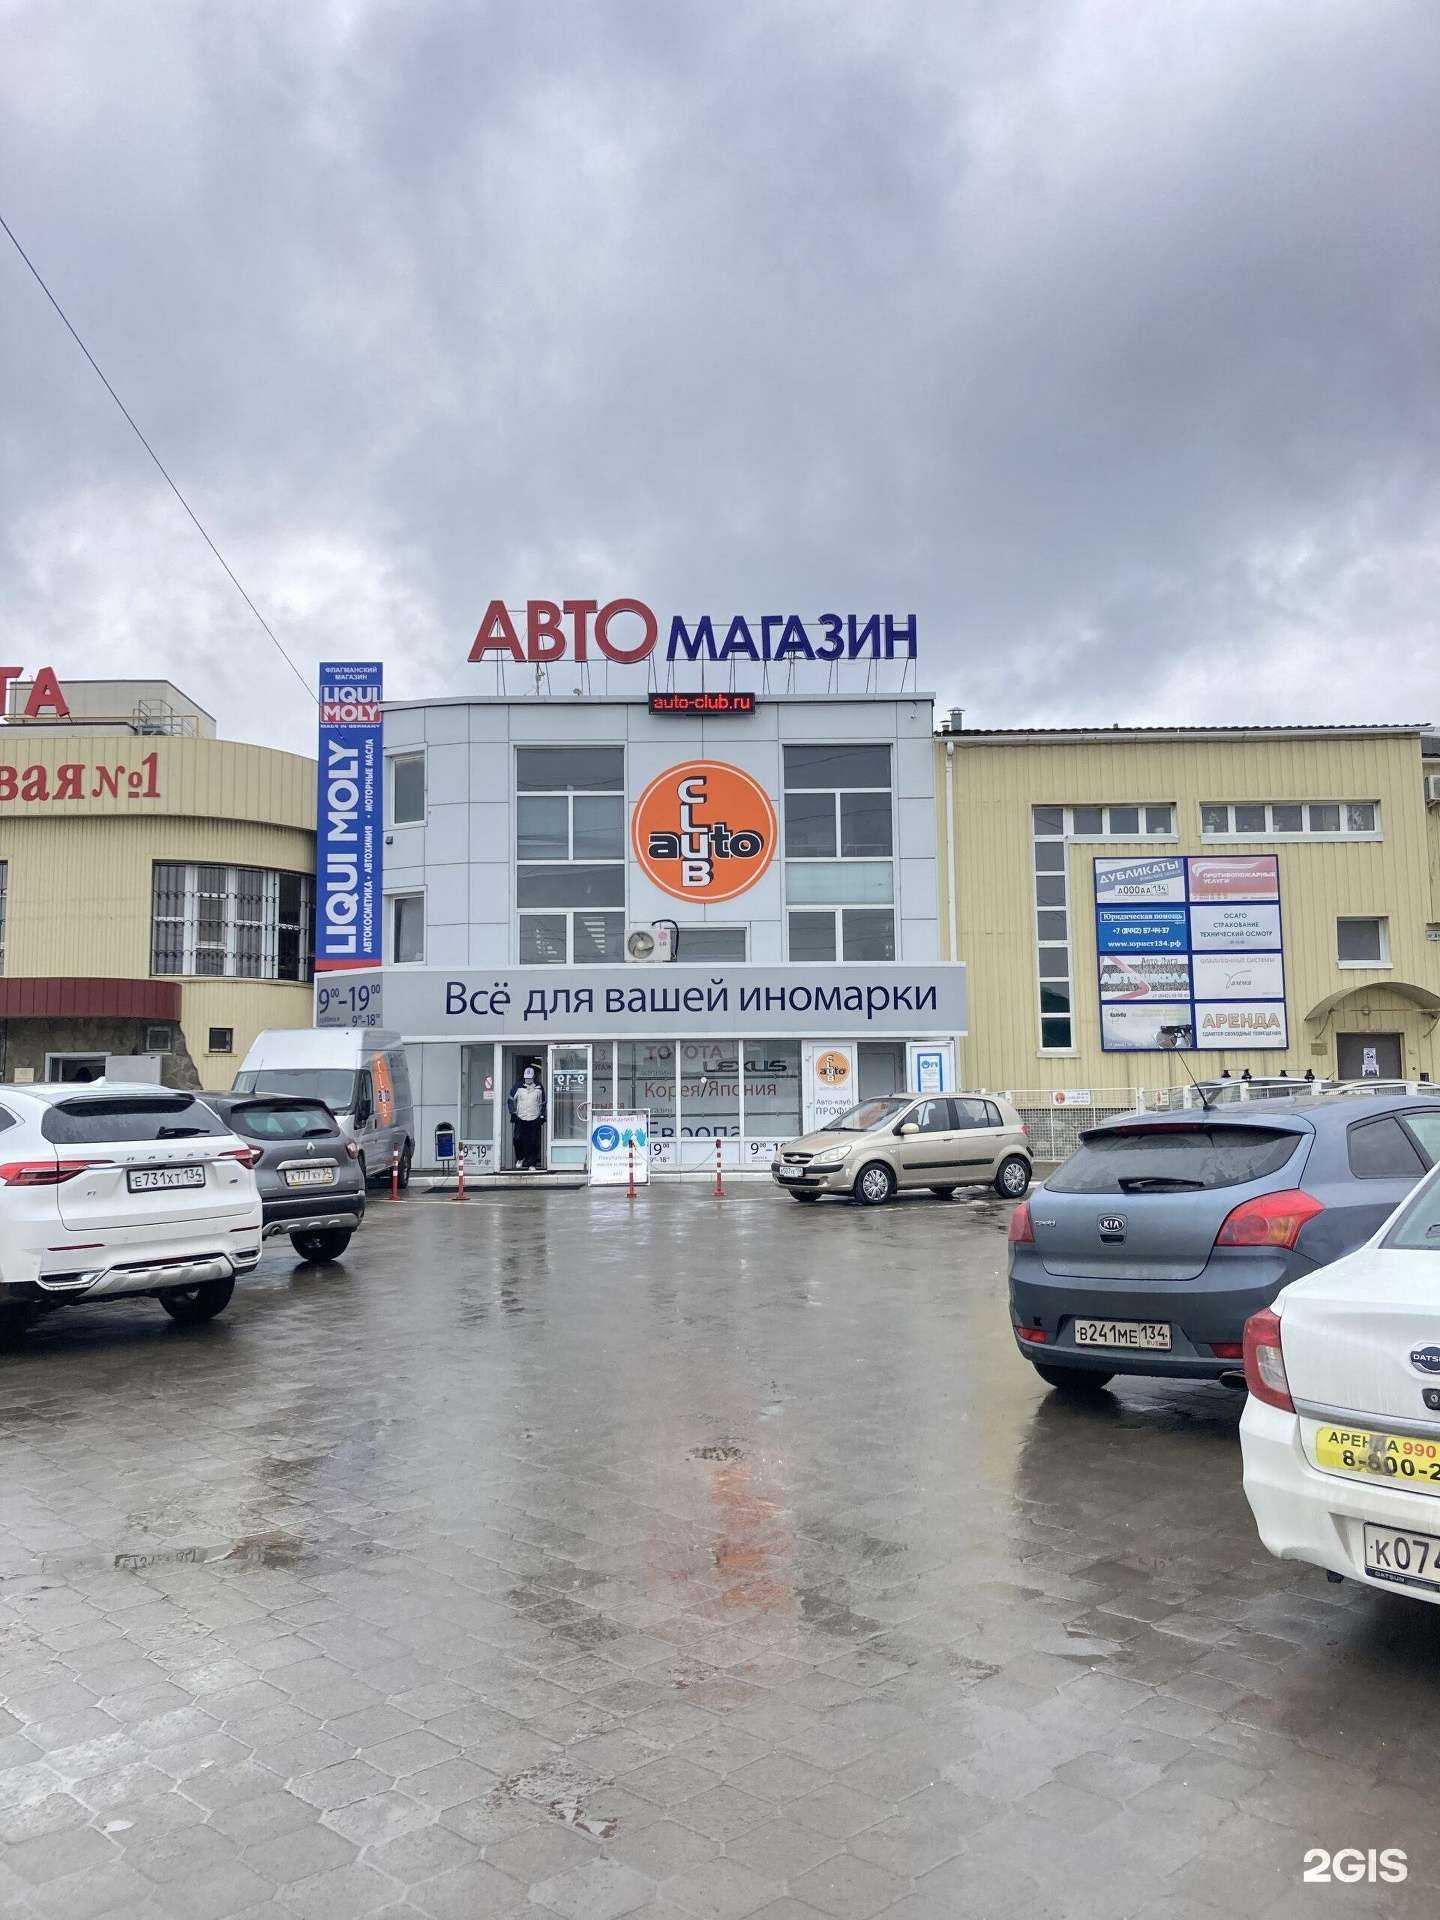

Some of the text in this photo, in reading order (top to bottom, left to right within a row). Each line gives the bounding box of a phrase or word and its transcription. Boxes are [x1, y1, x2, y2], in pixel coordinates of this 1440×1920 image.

[467, 598, 658, 663] АВТО
[666, 613, 918, 661] МАГАЗИН
[323, 687, 380, 704] LIQUI
[654, 694, 751, 710] auto-club.ru
[323, 704, 378, 721] MOLY
[91, 751, 161, 799] №1
[325, 739, 360, 954] LIQUI MOLY
[362, 738, 374, 953] АВТОКОСМЕТИКА АВТОХИМИЯ МОТОРНЫЕ МАСЛА
[1100, 860, 1180, 884] ДУБЛИКАТЫ
[445, 979, 938, 1022] Всё для вашей иномарки
[1202, 1012, 1281, 1030] АРЕНДА
[134, 1171, 182, 1187] Е731ХТ
[1103, 1220, 1120, 1229] KIA
[1080, 1323, 1166, 1344] В241МЕ 134
[1413, 1353, 1440, 1363] DATS
[1328, 1431, 1438, 1459] АРЕНА 990
